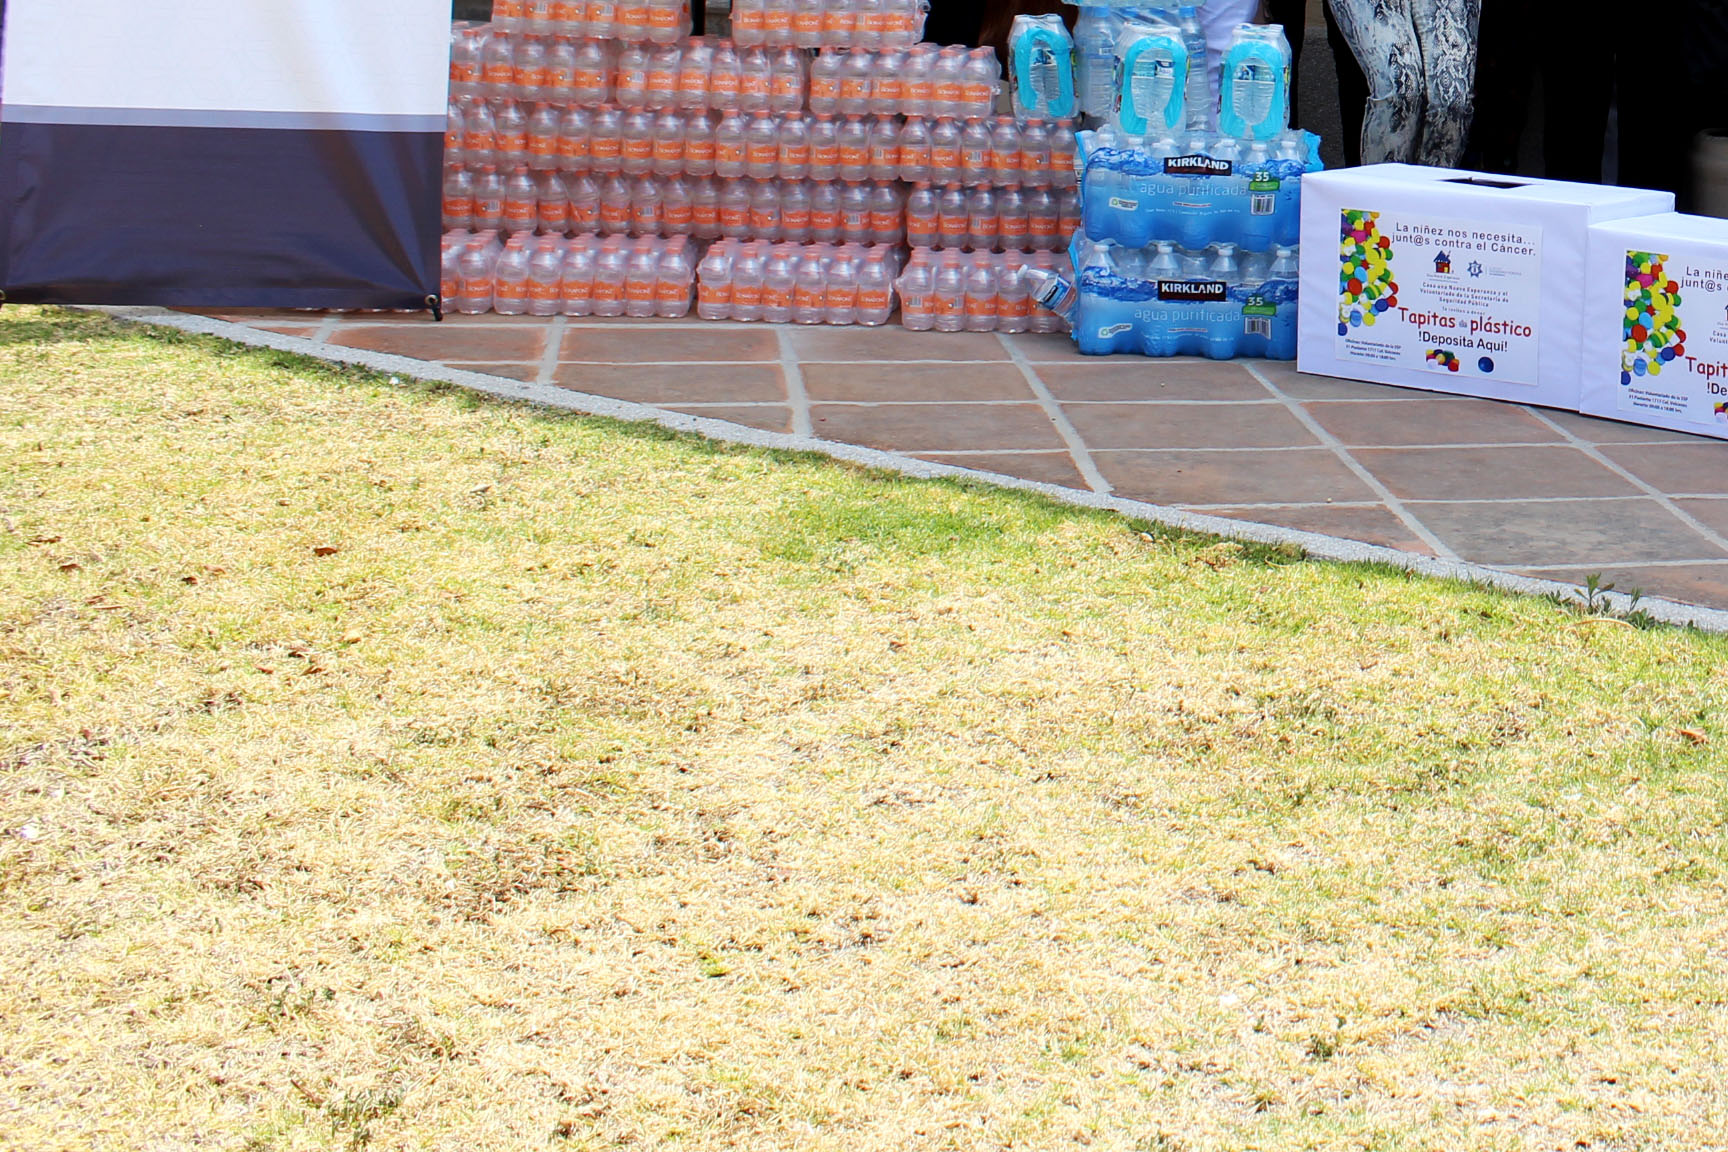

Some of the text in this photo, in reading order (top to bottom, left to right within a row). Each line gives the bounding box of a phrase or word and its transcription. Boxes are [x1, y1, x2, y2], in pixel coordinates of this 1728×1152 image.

[1168, 158, 1229, 170] KIRKLAND
[1255, 172, 1270, 182] 35
[1140, 183, 1247, 196] agua purificada
[1161, 283, 1224, 294] KIRKLAND
[1247, 297, 1264, 306] 35
[1134, 309, 1240, 322] agua purificada
[1398, 307, 1456, 329] Tapitas
[1470, 313, 1531, 337] plástico
[1419, 331, 1507, 353] !Deposita Aquí!
